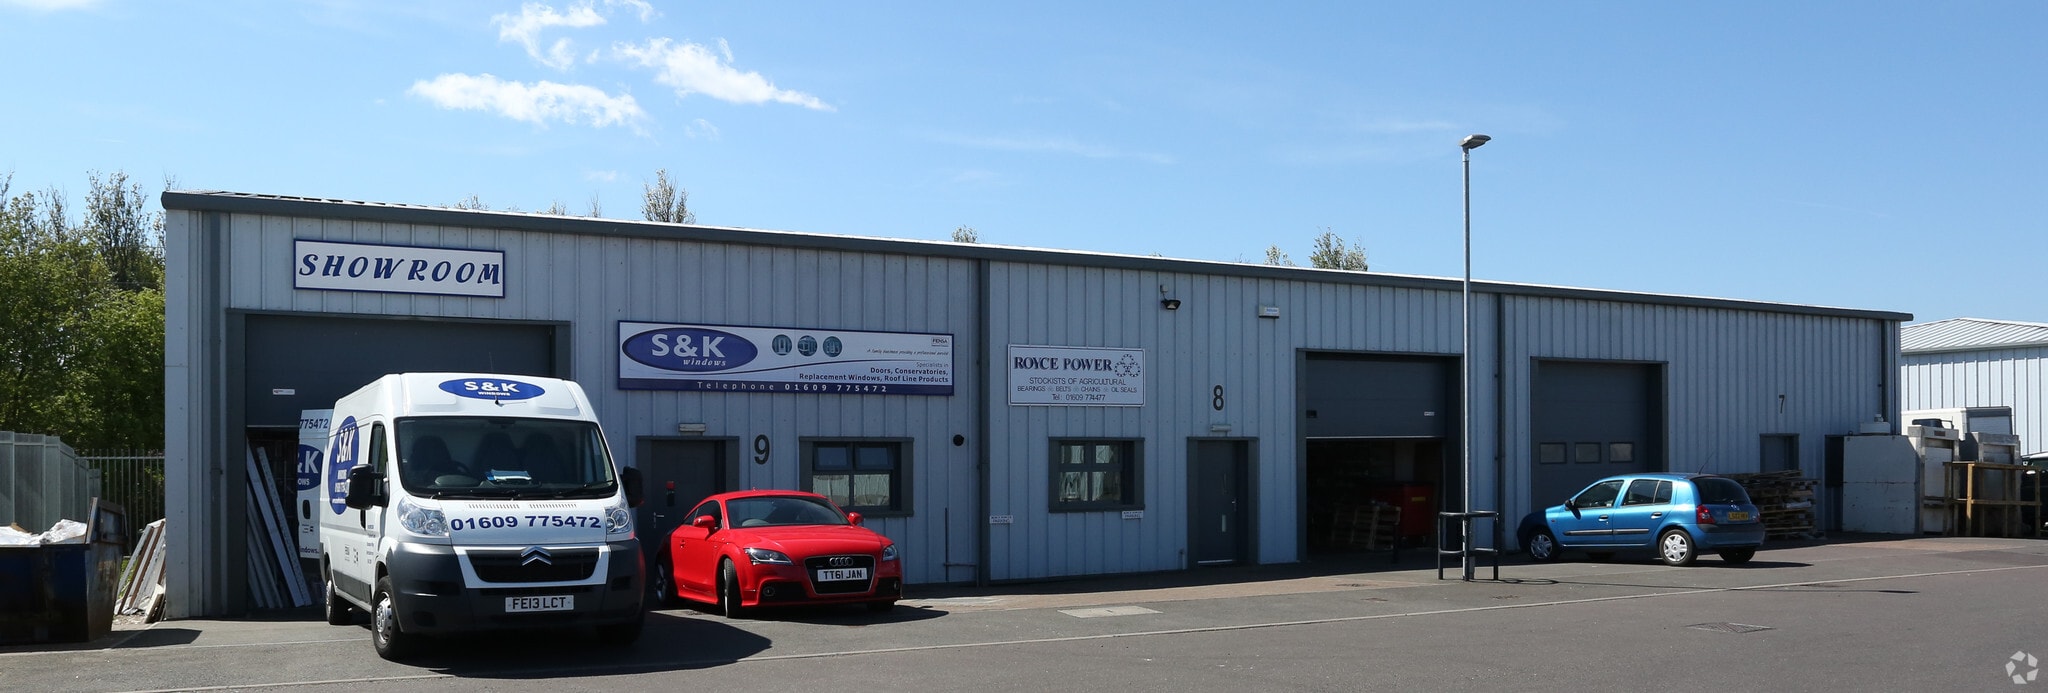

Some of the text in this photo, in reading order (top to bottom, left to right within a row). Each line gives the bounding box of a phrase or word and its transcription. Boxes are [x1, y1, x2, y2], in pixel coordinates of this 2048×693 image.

[299, 253, 500, 285] SHOWROOM
[651, 333, 726, 358] S&K
[683, 358, 726, 367] windows
[1013, 356, 1112, 371] ROYCE POWER
[799, 373, 847, 381] Replacement
[847, 374, 883, 382] Windows,
[895, 367, 949, 376] Conservatories,
[464, 381, 520, 393] S&K
[697, 381, 887, 392] Telephone 01609 775472
[1029, 377, 1126, 386] STOCKISTS OF AGRICULTURAL
[1212, 384, 1224, 411] 8
[1778, 394, 1785, 414] 7
[754, 434, 770, 465] 9
[450, 515, 602, 531] 01609 775472
[823, 569, 863, 580] TT61 JAN
[512, 597, 567, 610] FE13 LCT
